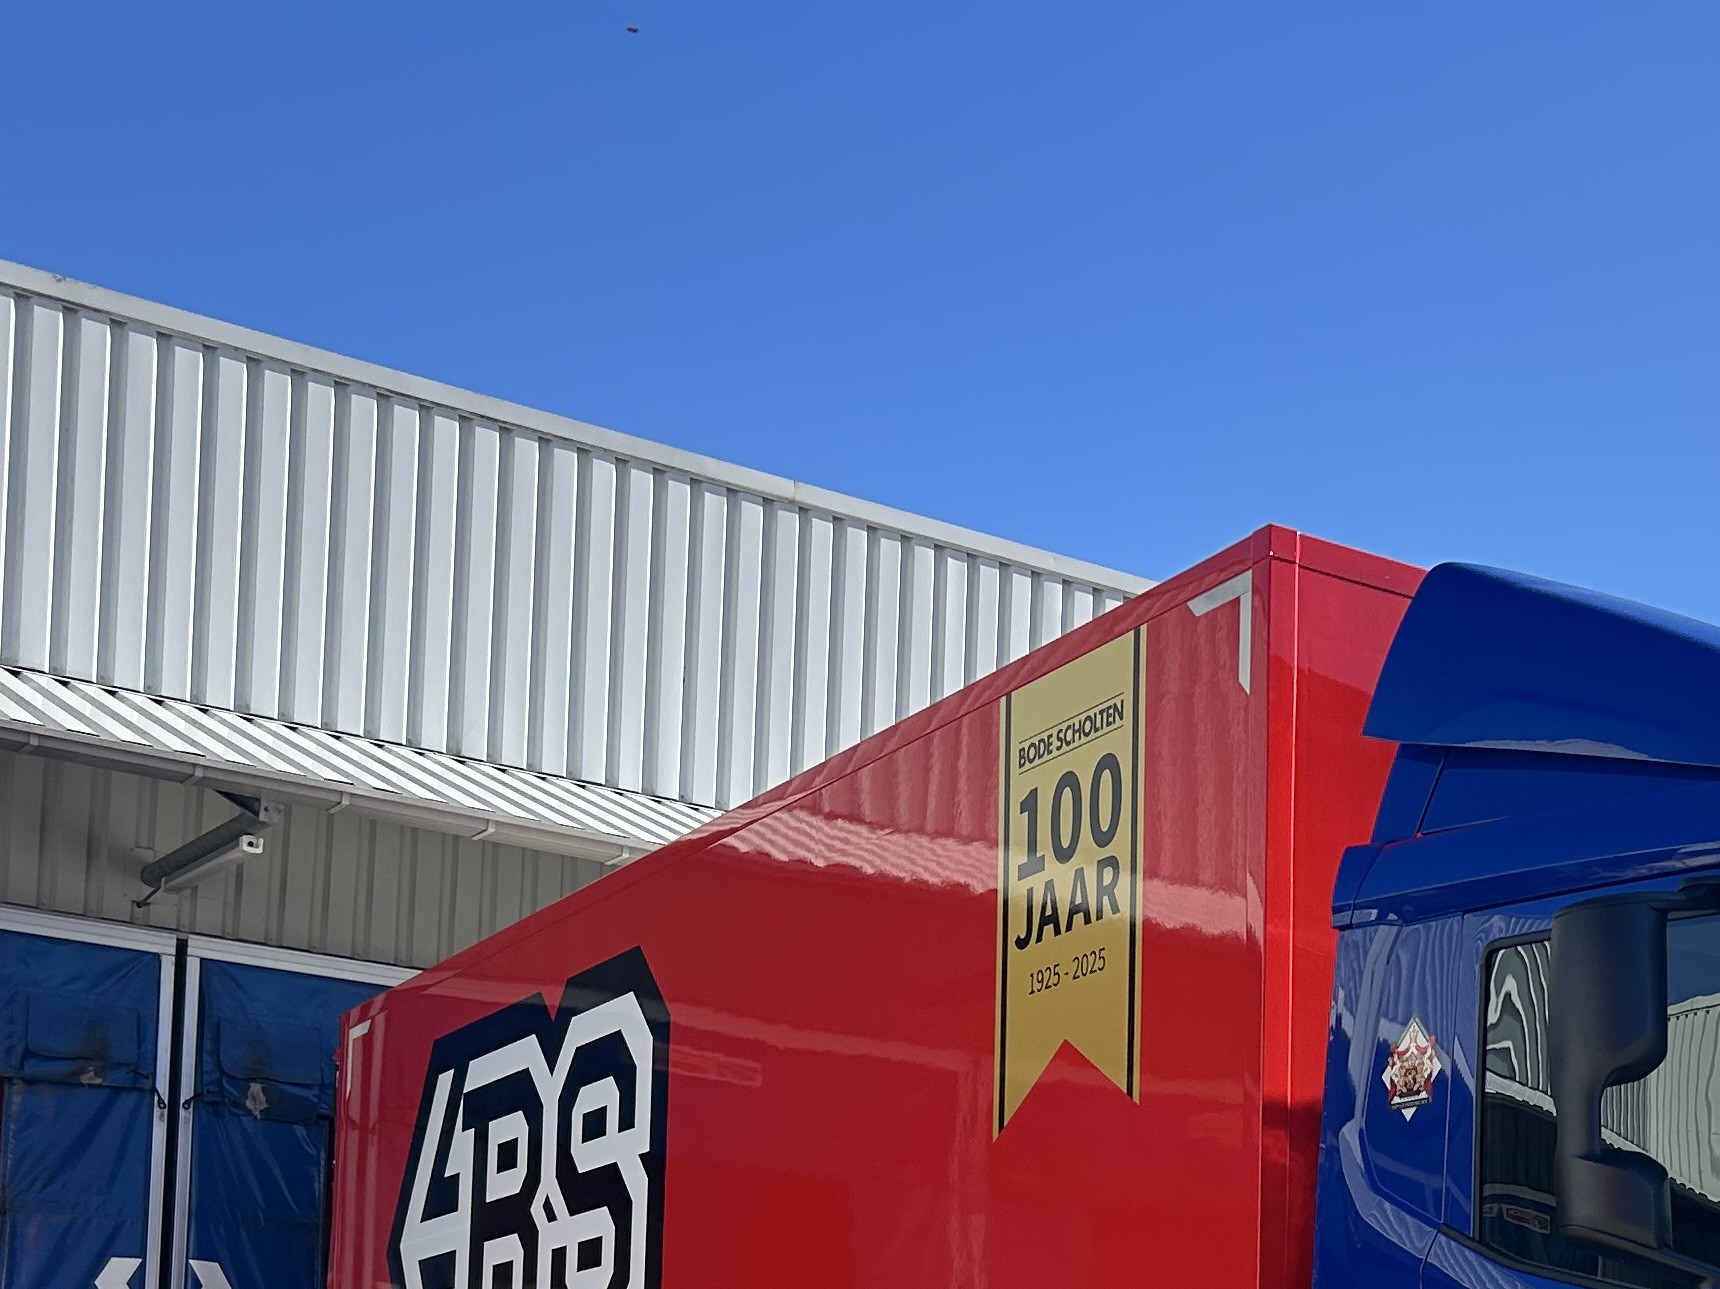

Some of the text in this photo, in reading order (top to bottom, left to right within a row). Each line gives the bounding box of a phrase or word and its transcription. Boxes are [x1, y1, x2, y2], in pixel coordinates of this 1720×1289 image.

[1018, 699, 1125, 769] BODE SCHOLTEN
[1017, 752, 1122, 881] 100
[1014, 854, 1122, 950] JAAR
[1028, 962, 1061, 995] 1925
[1072, 946, 1106, 981] 2025
